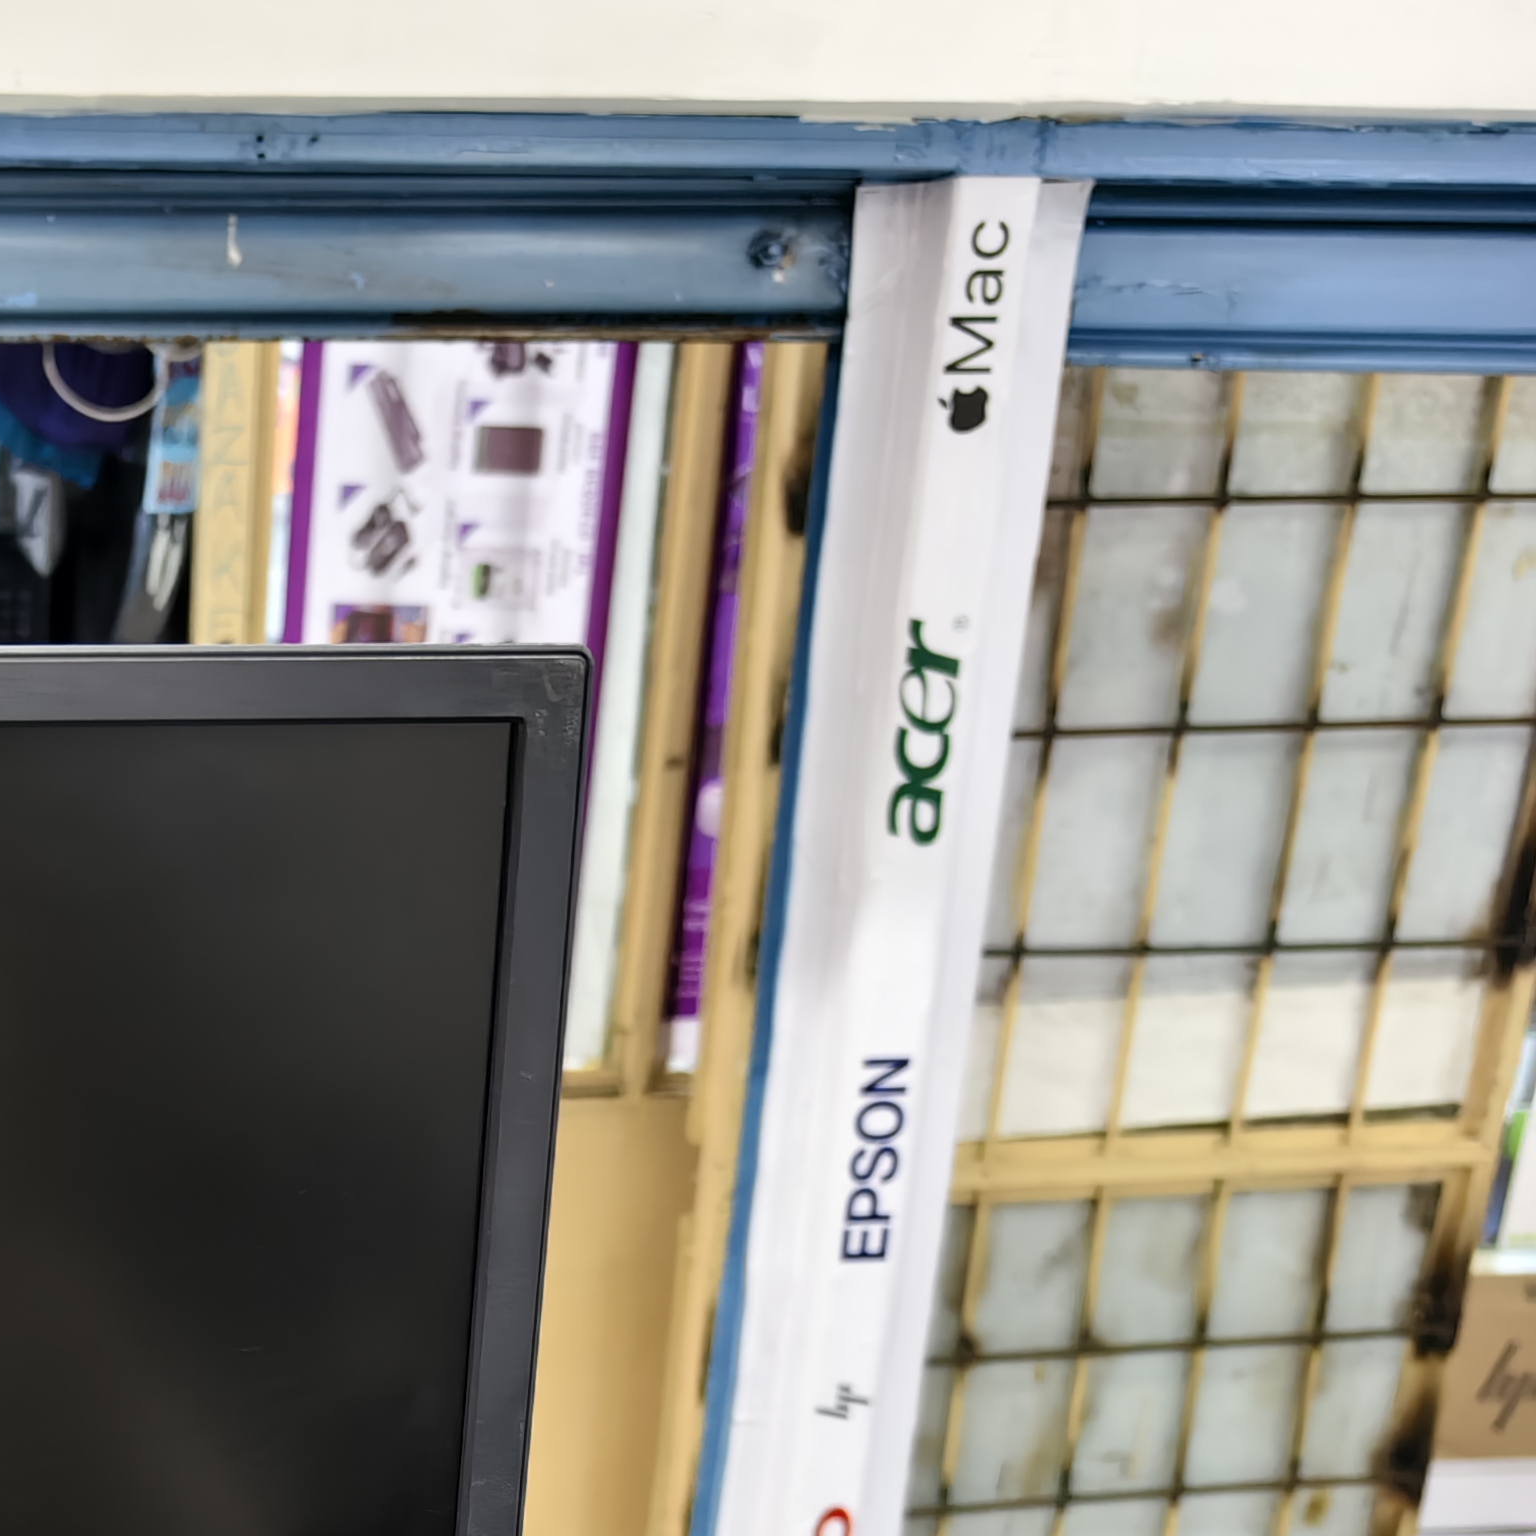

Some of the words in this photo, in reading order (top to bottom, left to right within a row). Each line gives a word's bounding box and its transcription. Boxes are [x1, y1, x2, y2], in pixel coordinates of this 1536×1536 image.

[944, 221, 1010, 376] Mac
[888, 619, 961, 845] acer
[841, 1056, 911, 1262] EPSON
